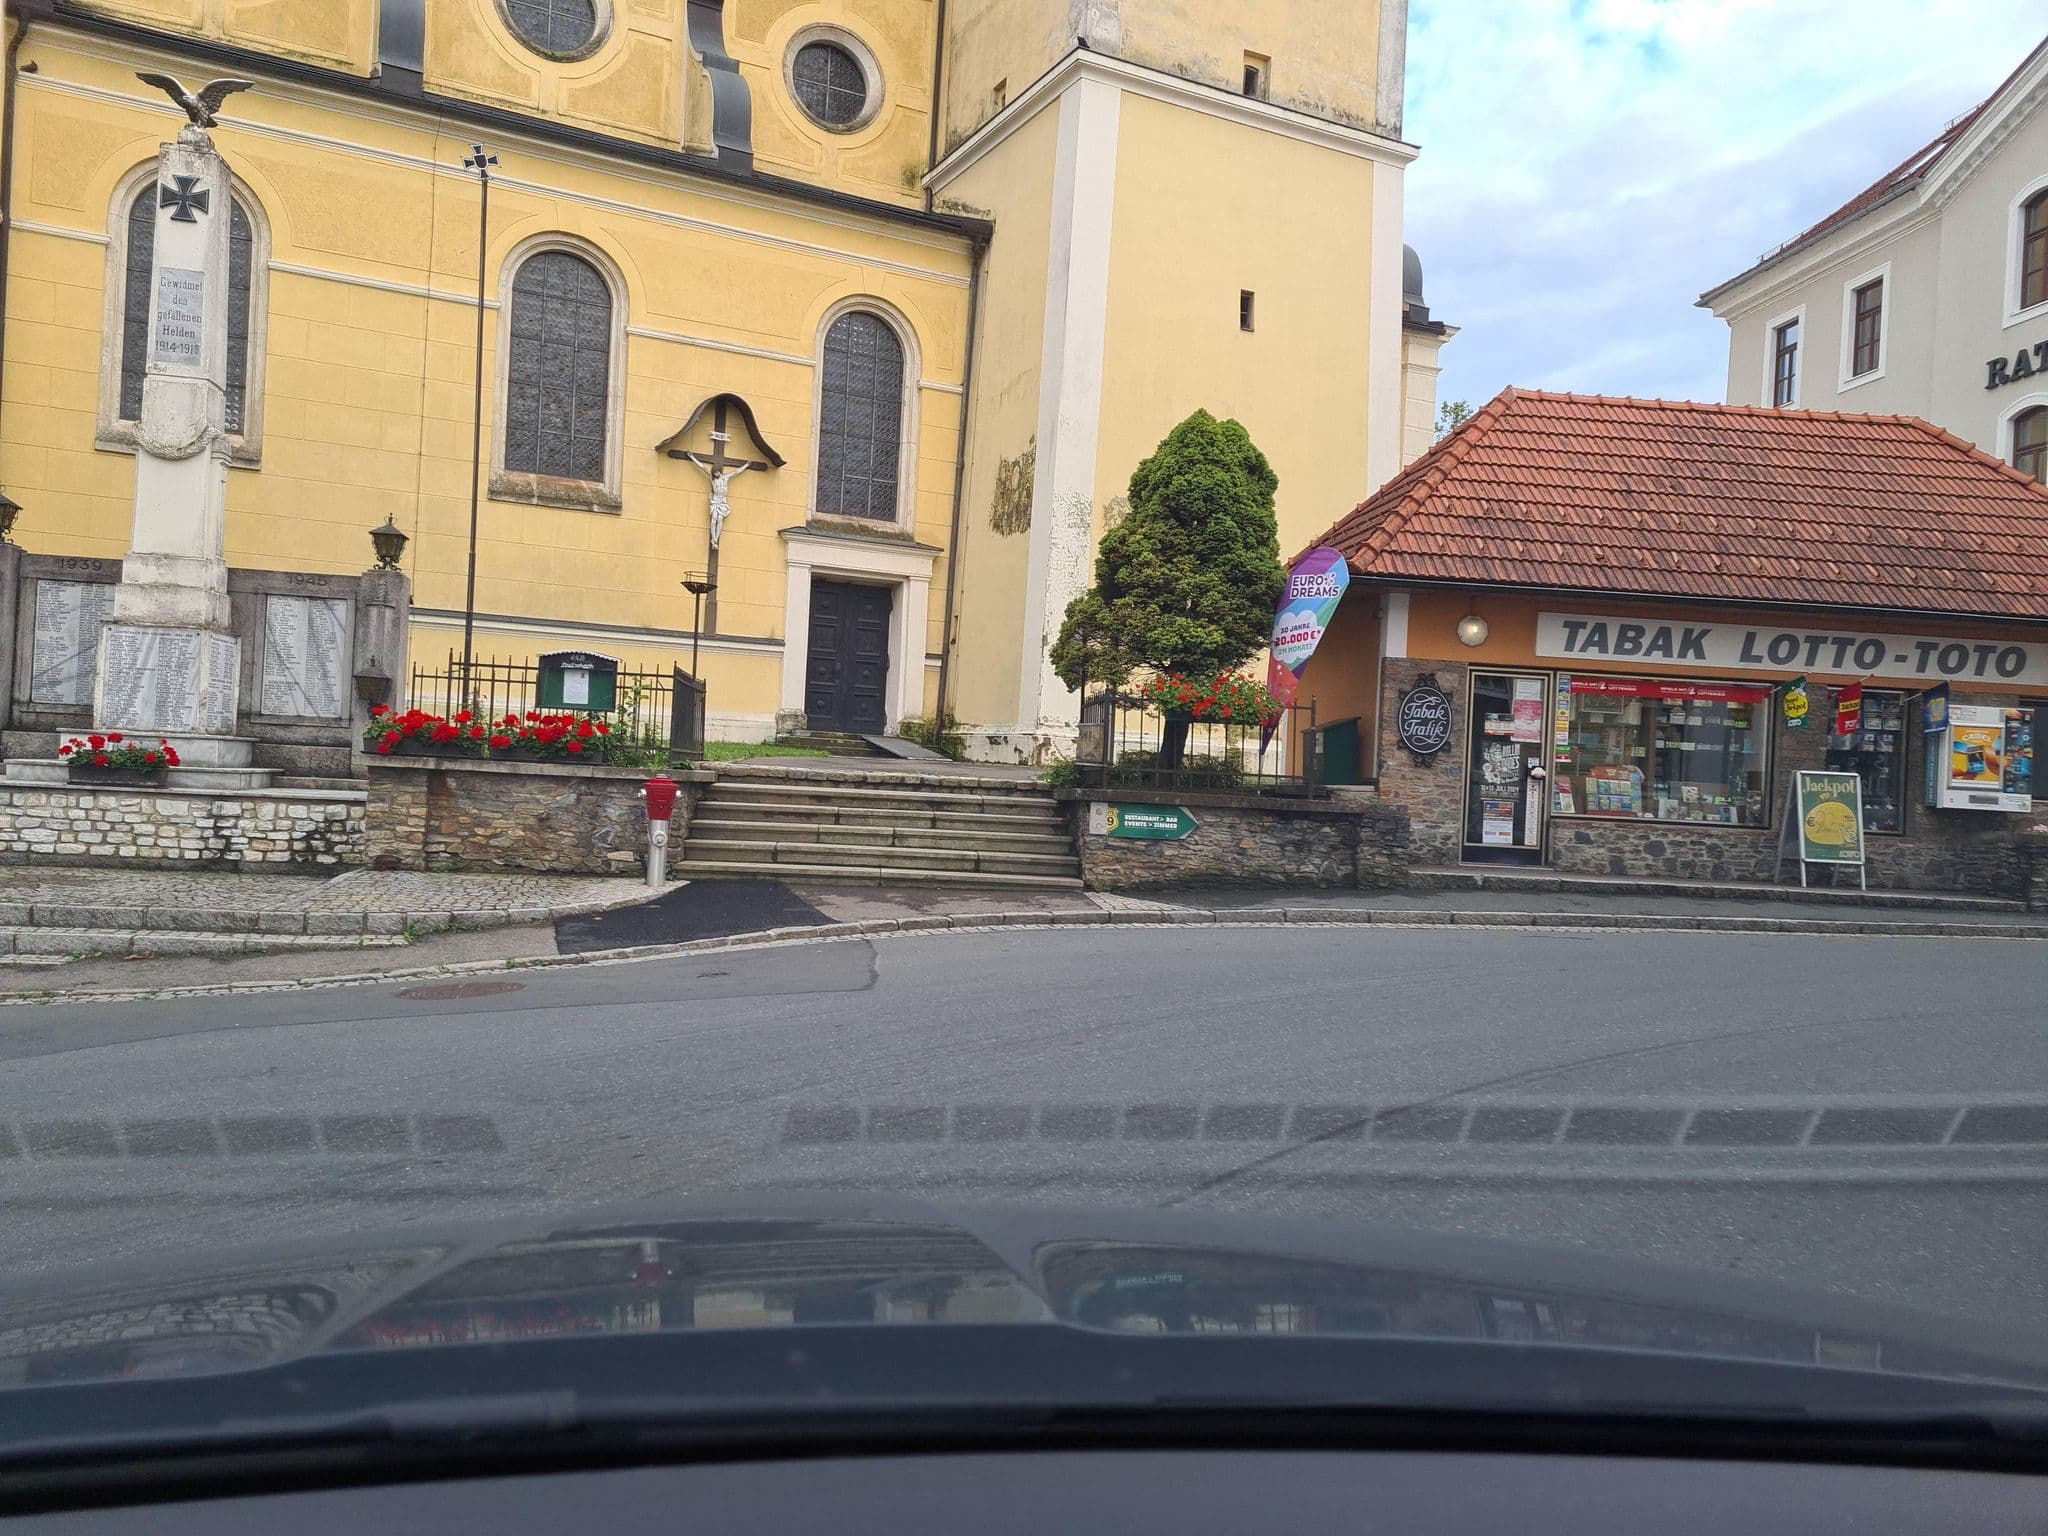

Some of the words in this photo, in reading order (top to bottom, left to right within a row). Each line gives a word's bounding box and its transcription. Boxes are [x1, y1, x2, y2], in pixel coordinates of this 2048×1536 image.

[160, 277, 202, 291] Gewidmet
[172, 294, 188, 306] den
[157, 309, 202, 323] gefallenen
[162, 325, 195, 338] Helden
[60, 558, 102, 570] 1939
[288, 575, 327, 587] 1945
[1292, 575, 1324, 587] EURO
[1291, 586, 1340, 598] DREAMS
[1280, 626, 1289, 634] 30
[1289, 623, 1311, 632] JAHRE
[1275, 634, 1309, 646] 20.000
[1562, 620, 1711, 660] TABAK
[1404, 702, 1448, 720] Tabak
[1404, 720, 1447, 737] Trafik
[1803, 776, 1857, 798] Jackpot
[1124, 814, 1160, 822] RESTAURANT
[1124, 820, 1148, 828] EVENTS
